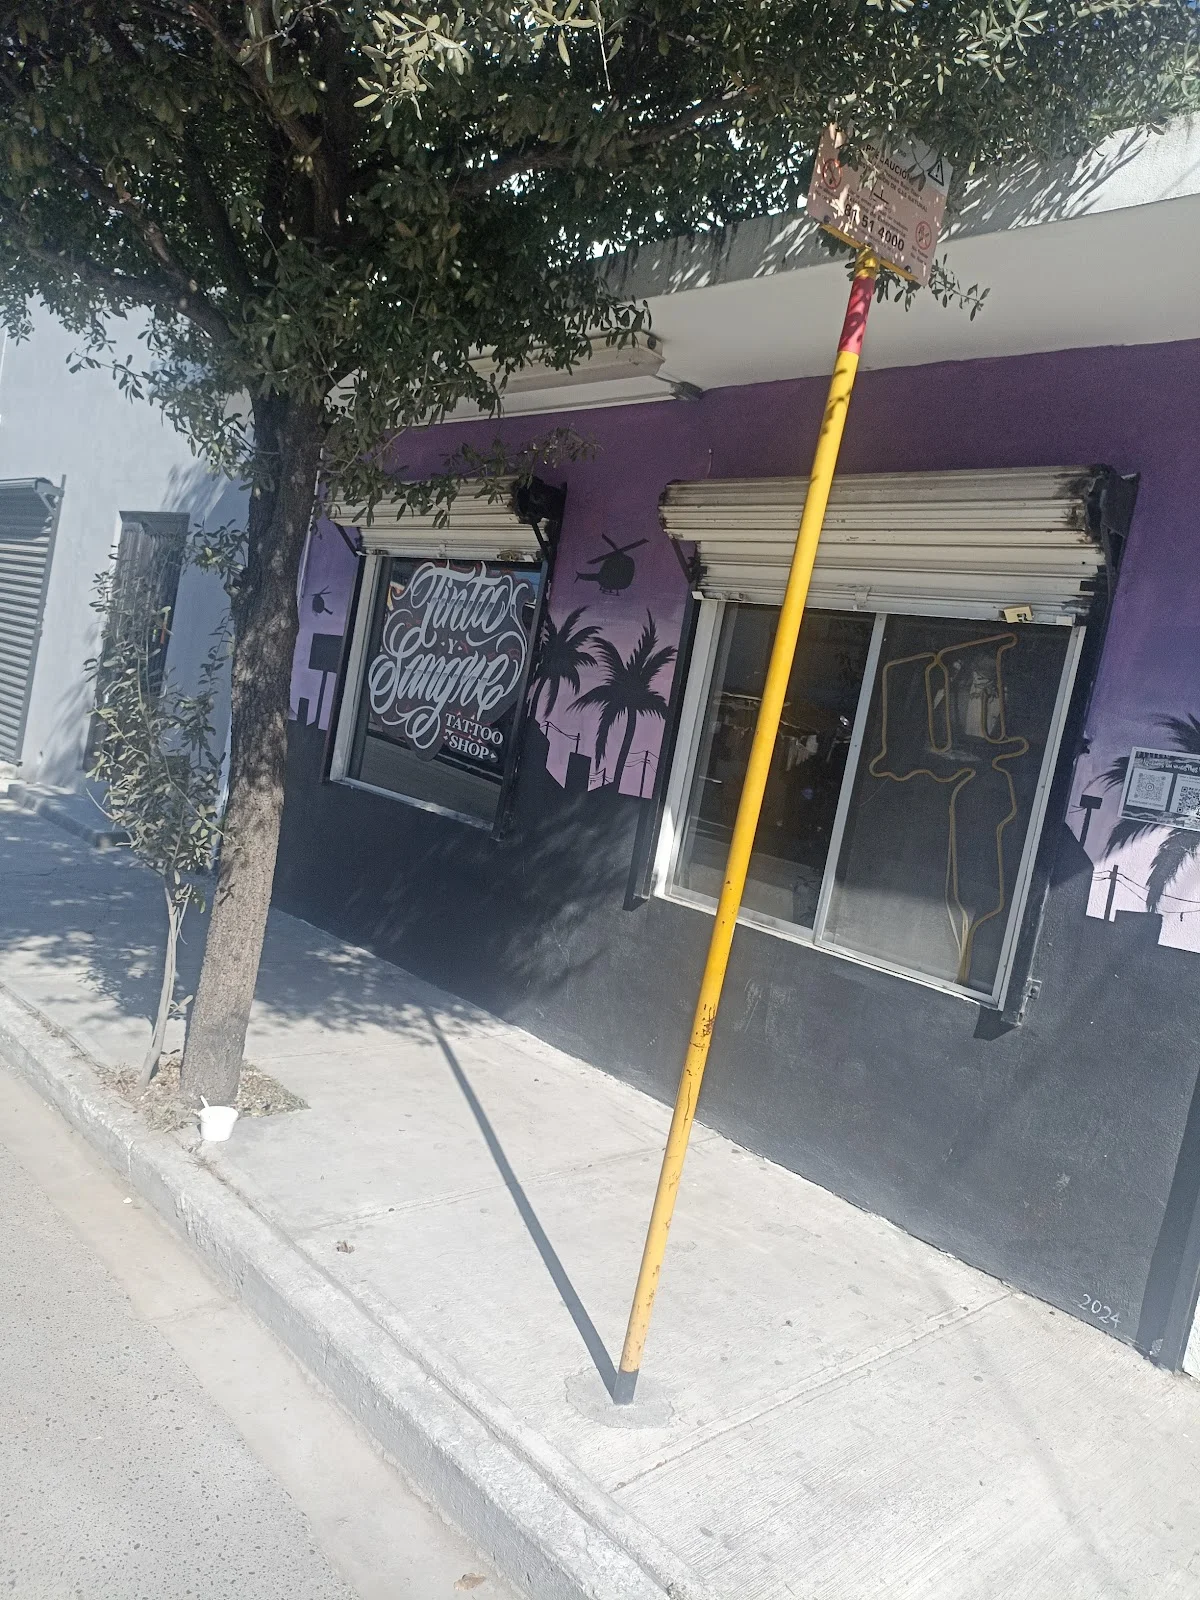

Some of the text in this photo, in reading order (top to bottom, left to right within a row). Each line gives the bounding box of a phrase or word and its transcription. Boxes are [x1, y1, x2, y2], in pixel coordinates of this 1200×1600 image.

[861, 214, 875, 232] 51
[878, 226, 905, 251] 4000
[445, 713, 504, 745] TATTOO
[449, 735, 490, 759] SHOP
[1078, 1293, 1122, 1329] 2024
